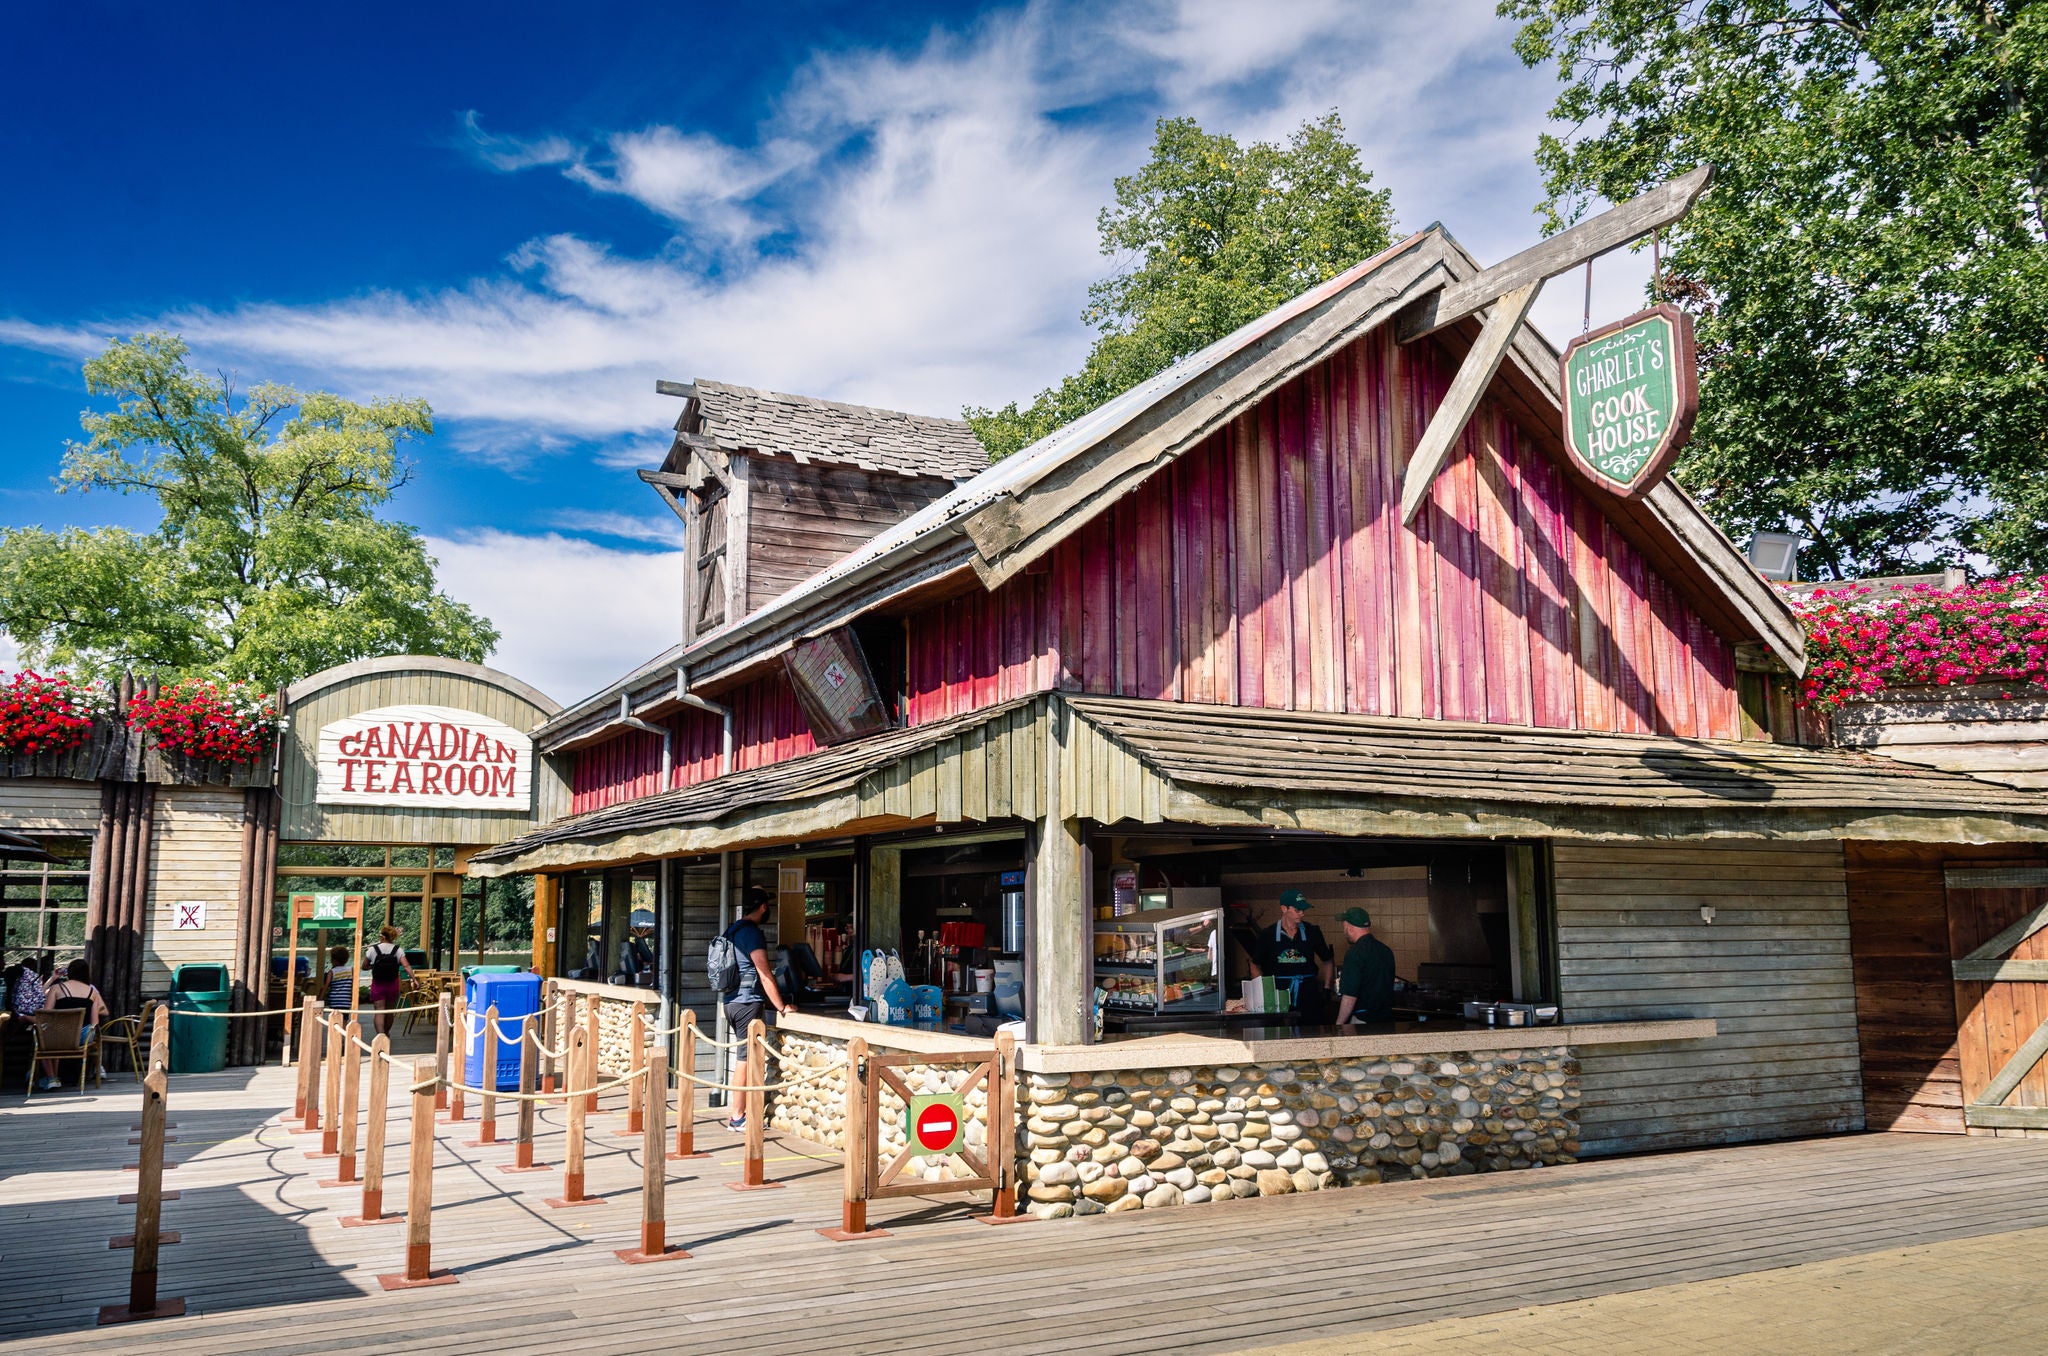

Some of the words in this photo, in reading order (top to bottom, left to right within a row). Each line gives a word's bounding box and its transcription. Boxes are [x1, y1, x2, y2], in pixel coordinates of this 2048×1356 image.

[1576, 339, 1664, 397] CHARLEY'S
[1591, 384, 1654, 428] COOK
[1587, 410, 1661, 459] HOUSE
[338, 721, 517, 763] CANADIAN
[337, 758, 516, 797] TEAROOM
[318, 907, 339, 917] NIC
[319, 895, 339, 905] PIC
[889, 1006, 905, 1015] Kids
[914, 1004, 932, 1013] Kids
